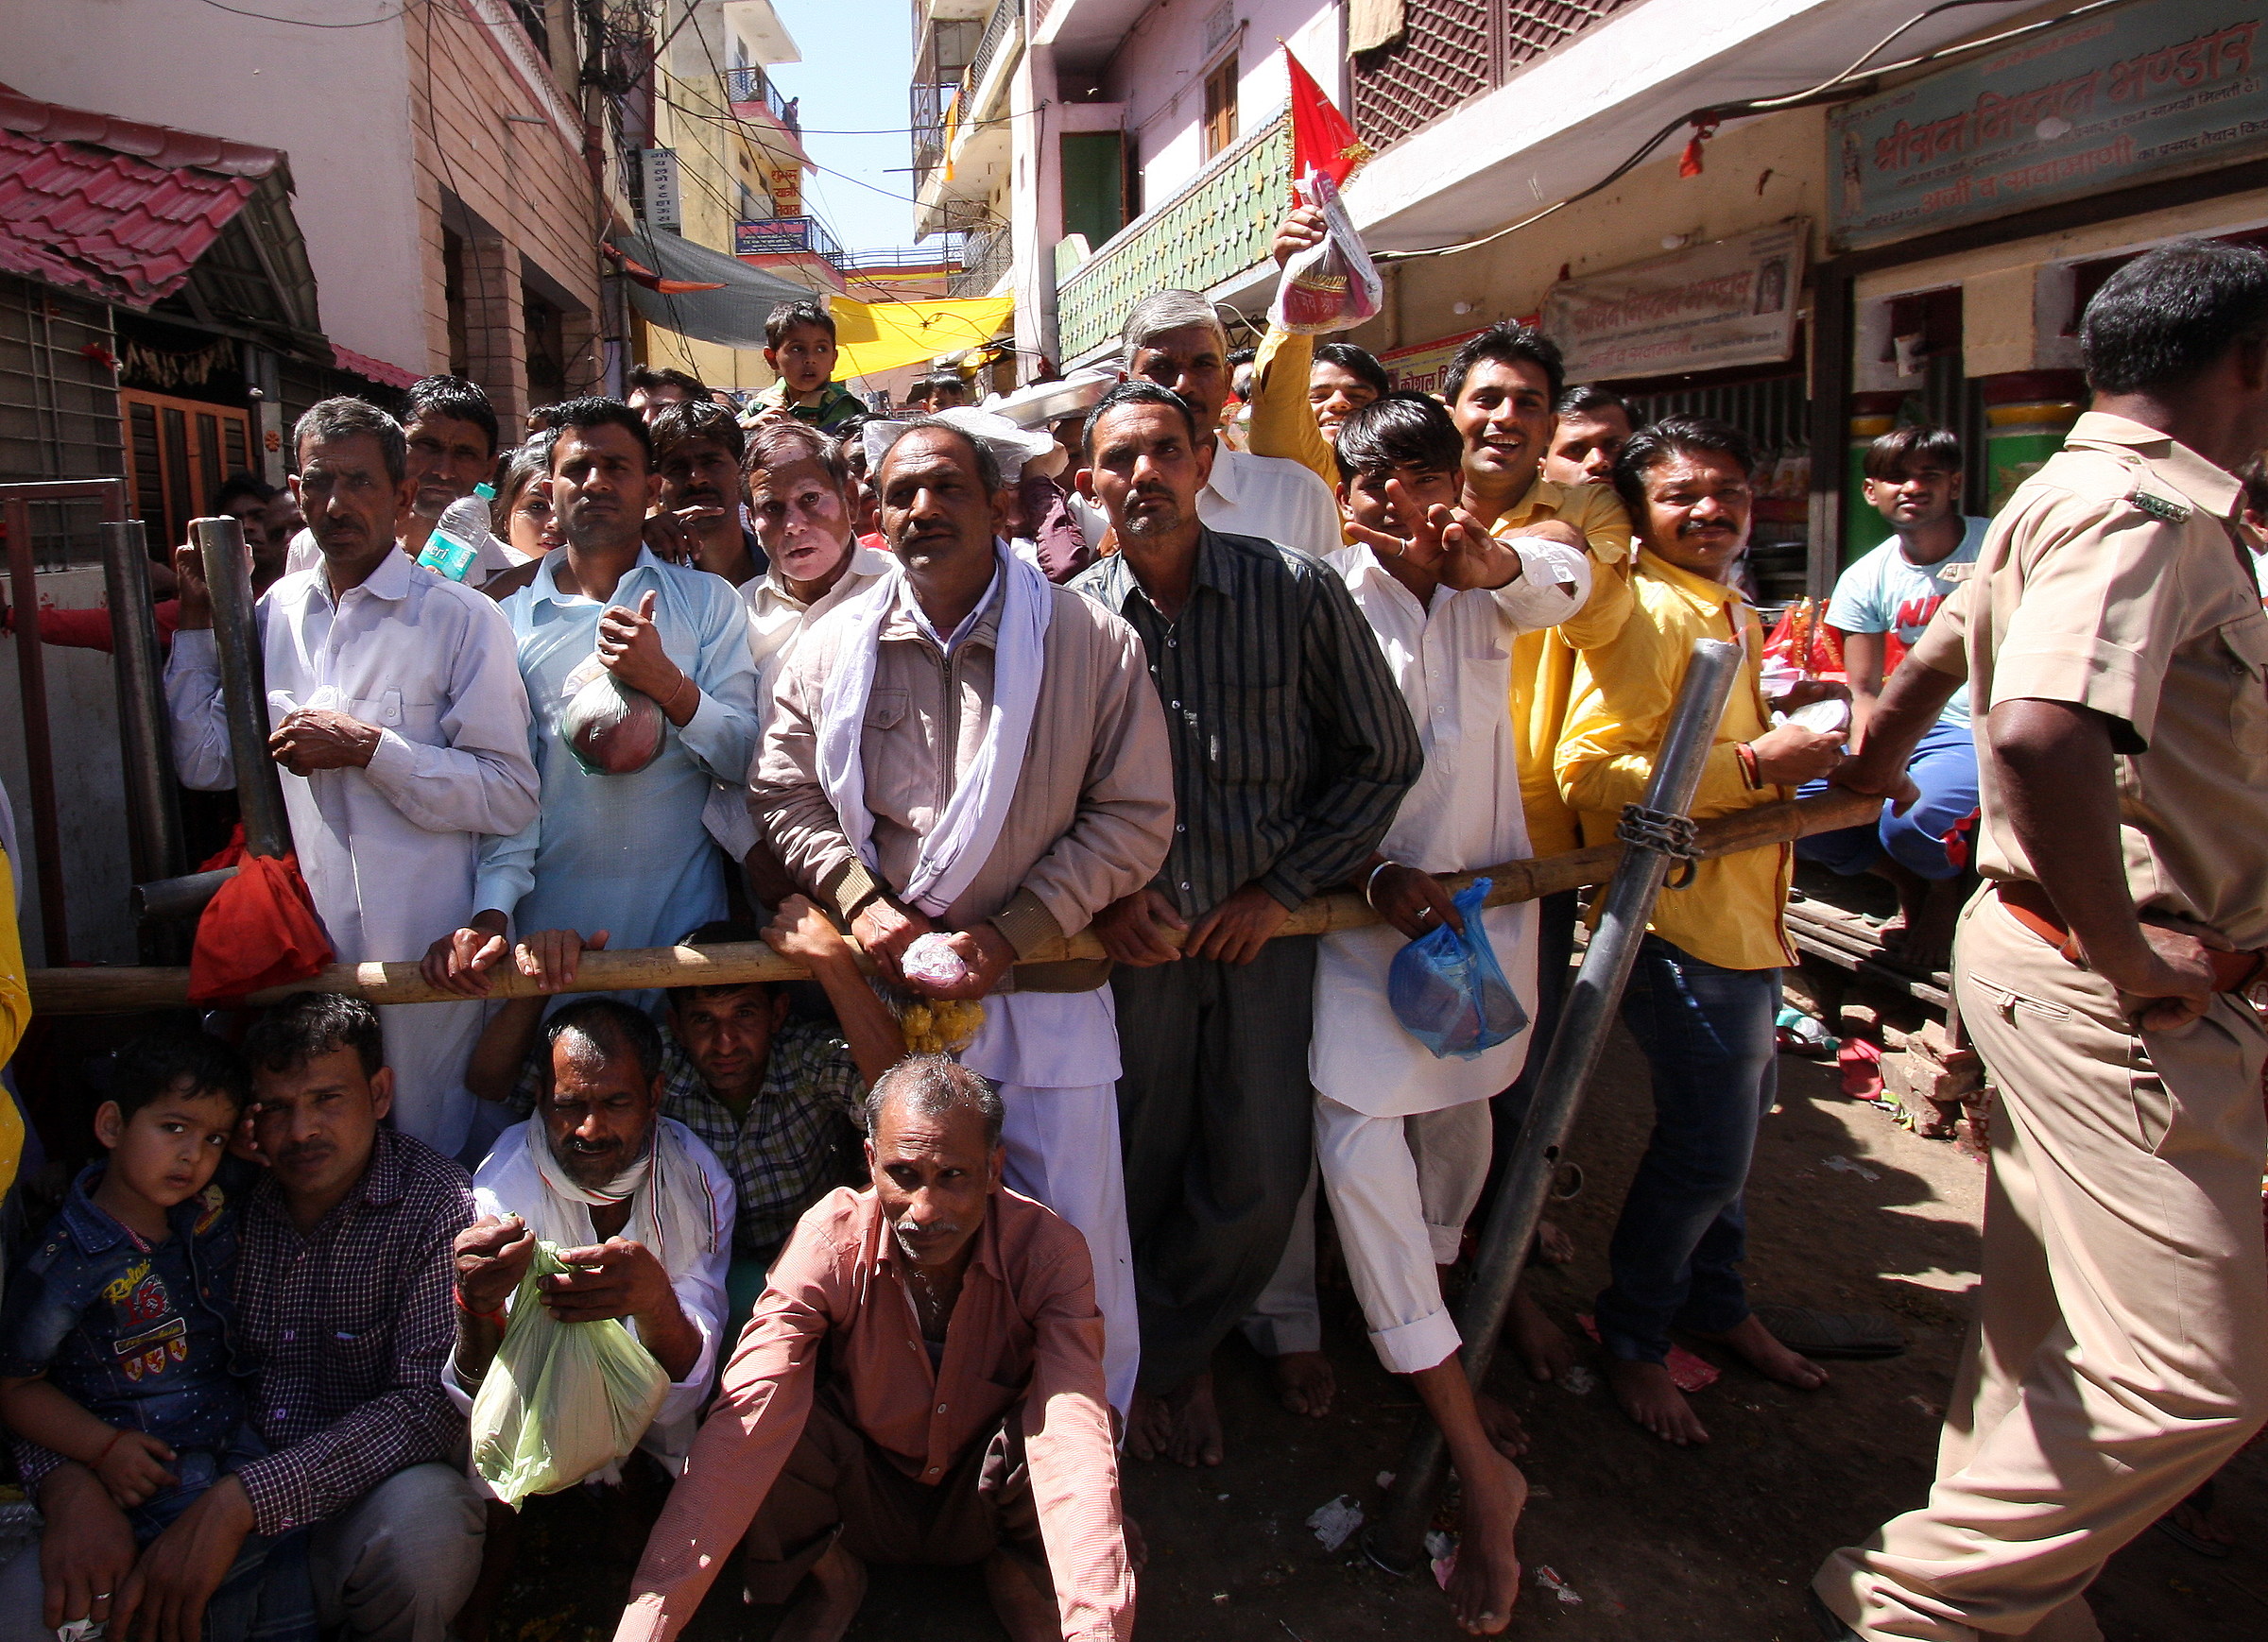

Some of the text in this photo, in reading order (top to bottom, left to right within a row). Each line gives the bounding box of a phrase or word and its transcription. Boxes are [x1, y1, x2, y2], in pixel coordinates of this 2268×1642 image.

[2107, 19, 2262, 101] भण्डार
[2199, 82, 2240, 104] मिलती
[1978, 178, 1999, 198] व
